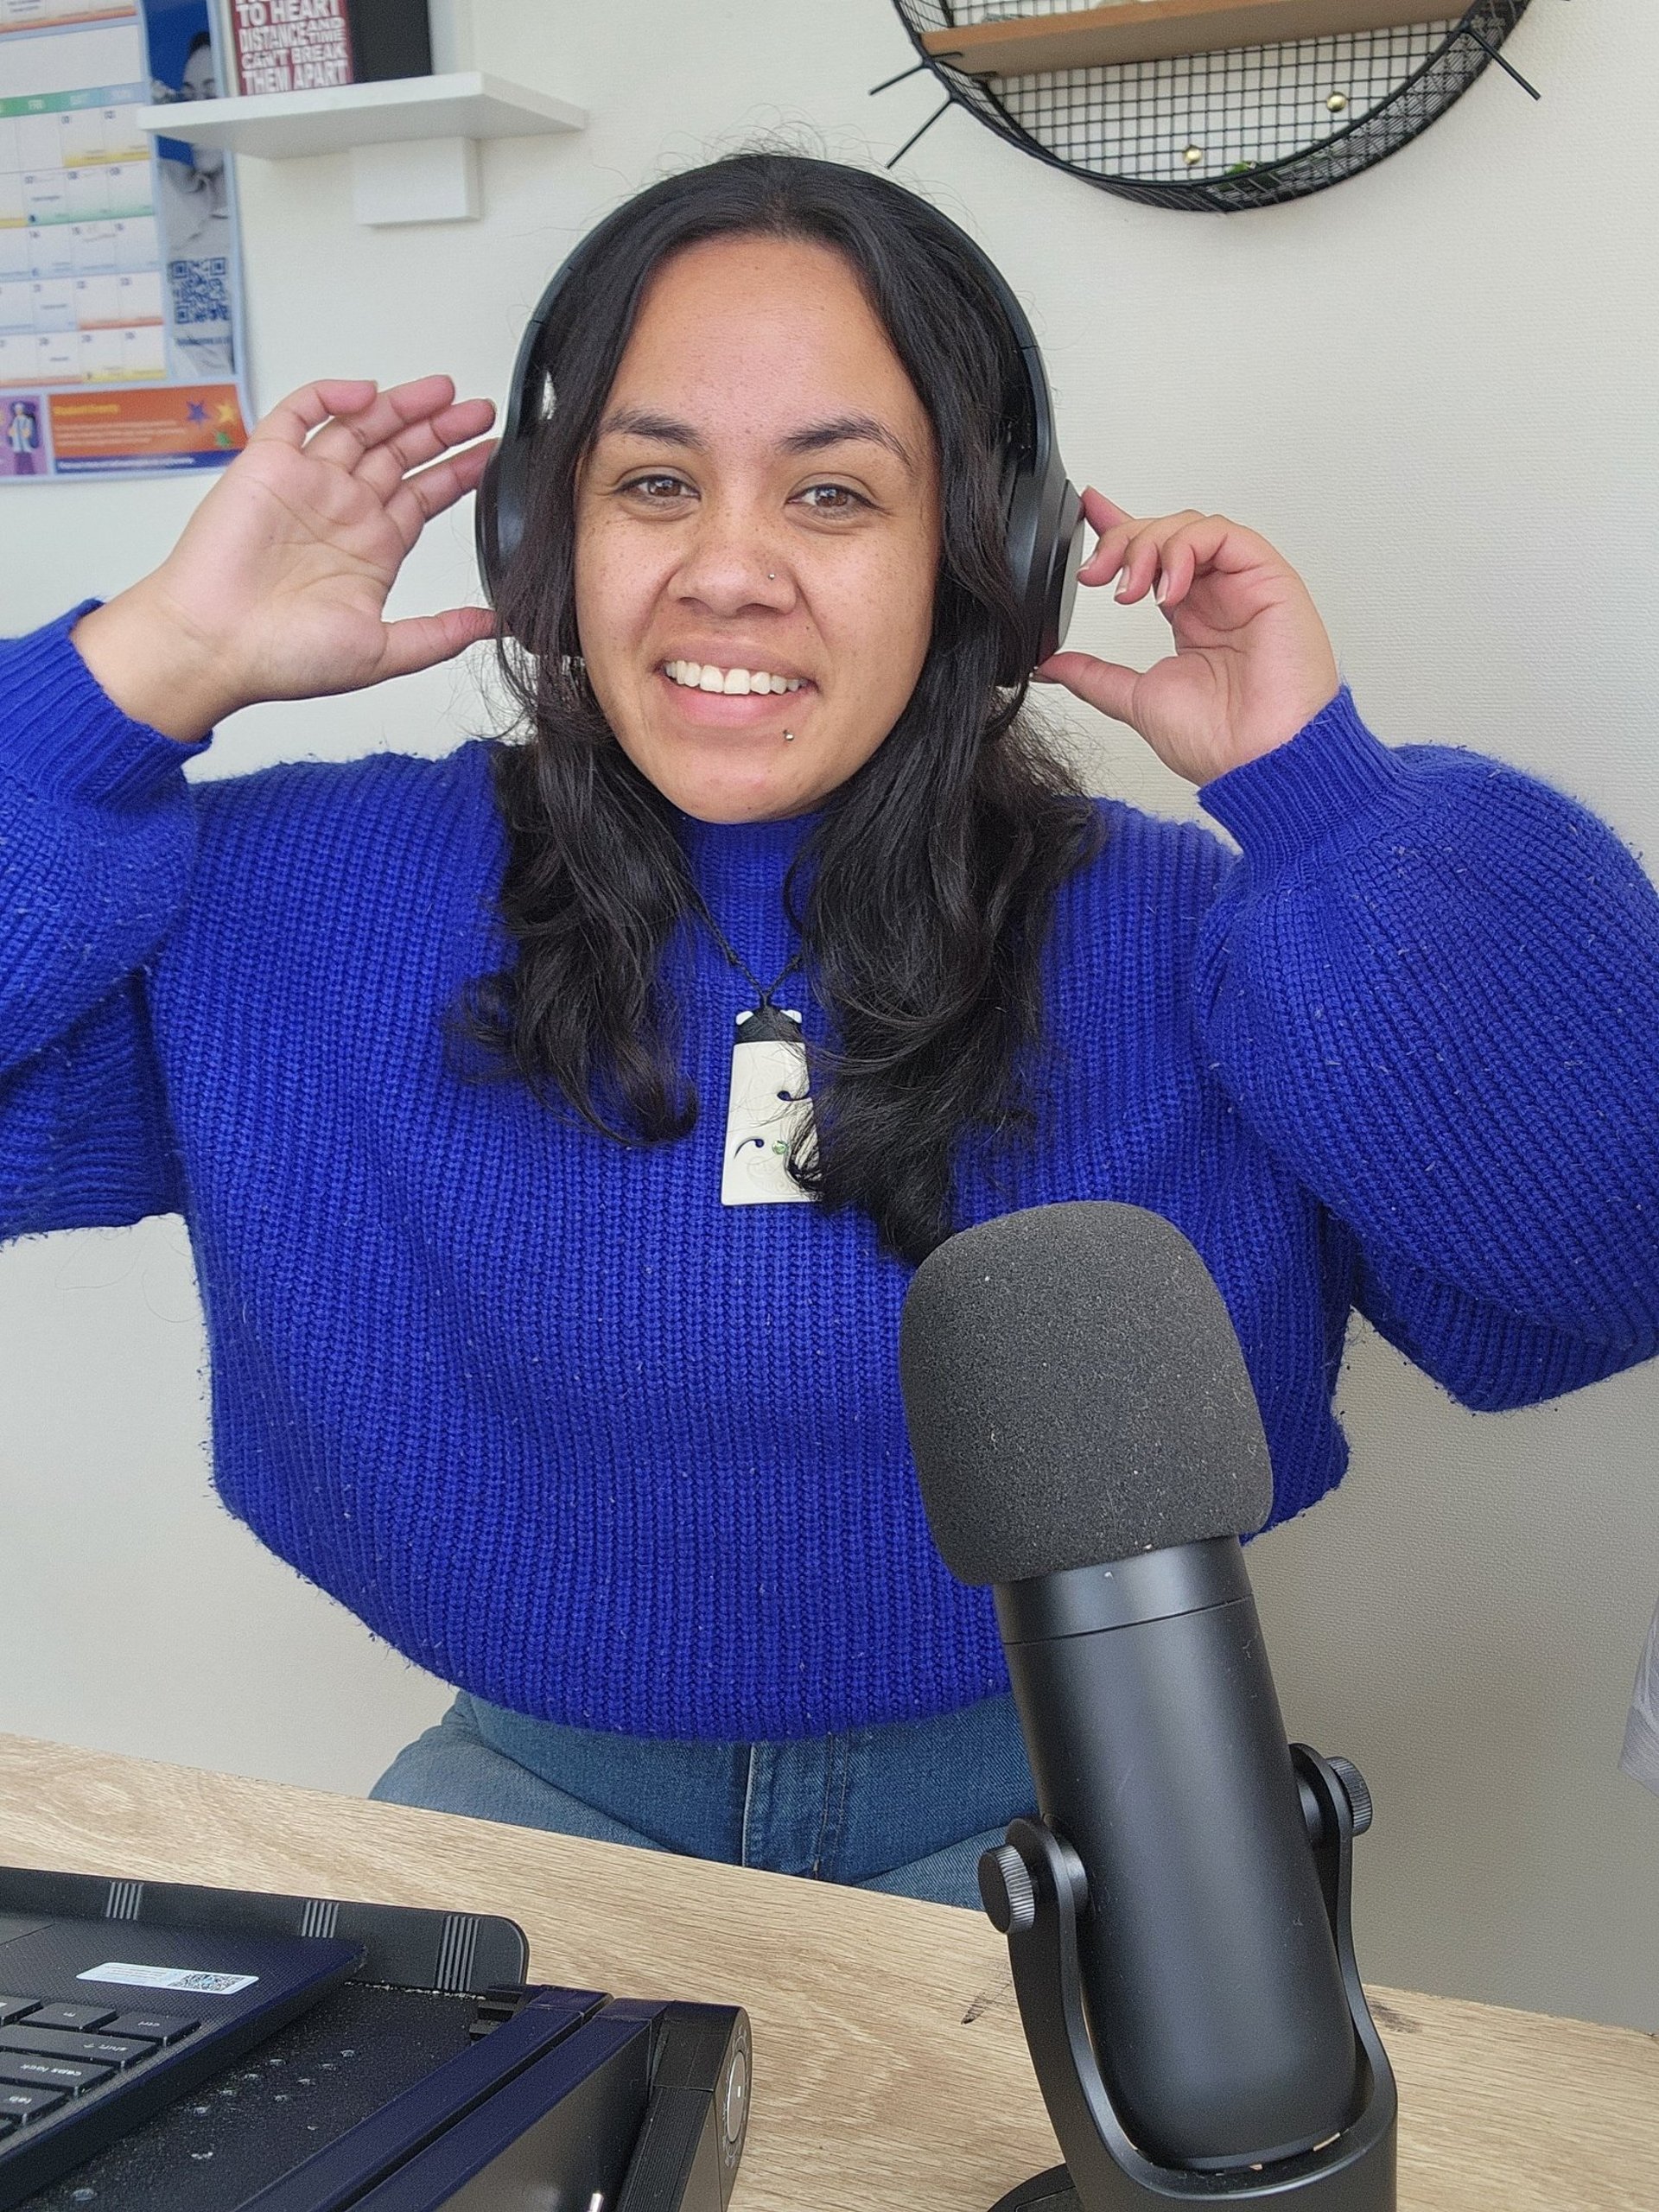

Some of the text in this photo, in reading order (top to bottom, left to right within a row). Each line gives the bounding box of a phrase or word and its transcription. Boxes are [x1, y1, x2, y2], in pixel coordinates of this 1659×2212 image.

[236, 2, 267, 29] TO
[238, 16, 346, 52] DISTANCE AND
[308, 29, 347, 44] TIME
[241, 41, 348, 70] CAN'T BREAK
[242, 60, 349, 95] THEM APART
[98, 2044, 128, 2052] shift
[21, 2063, 82, 2077] caps lock
